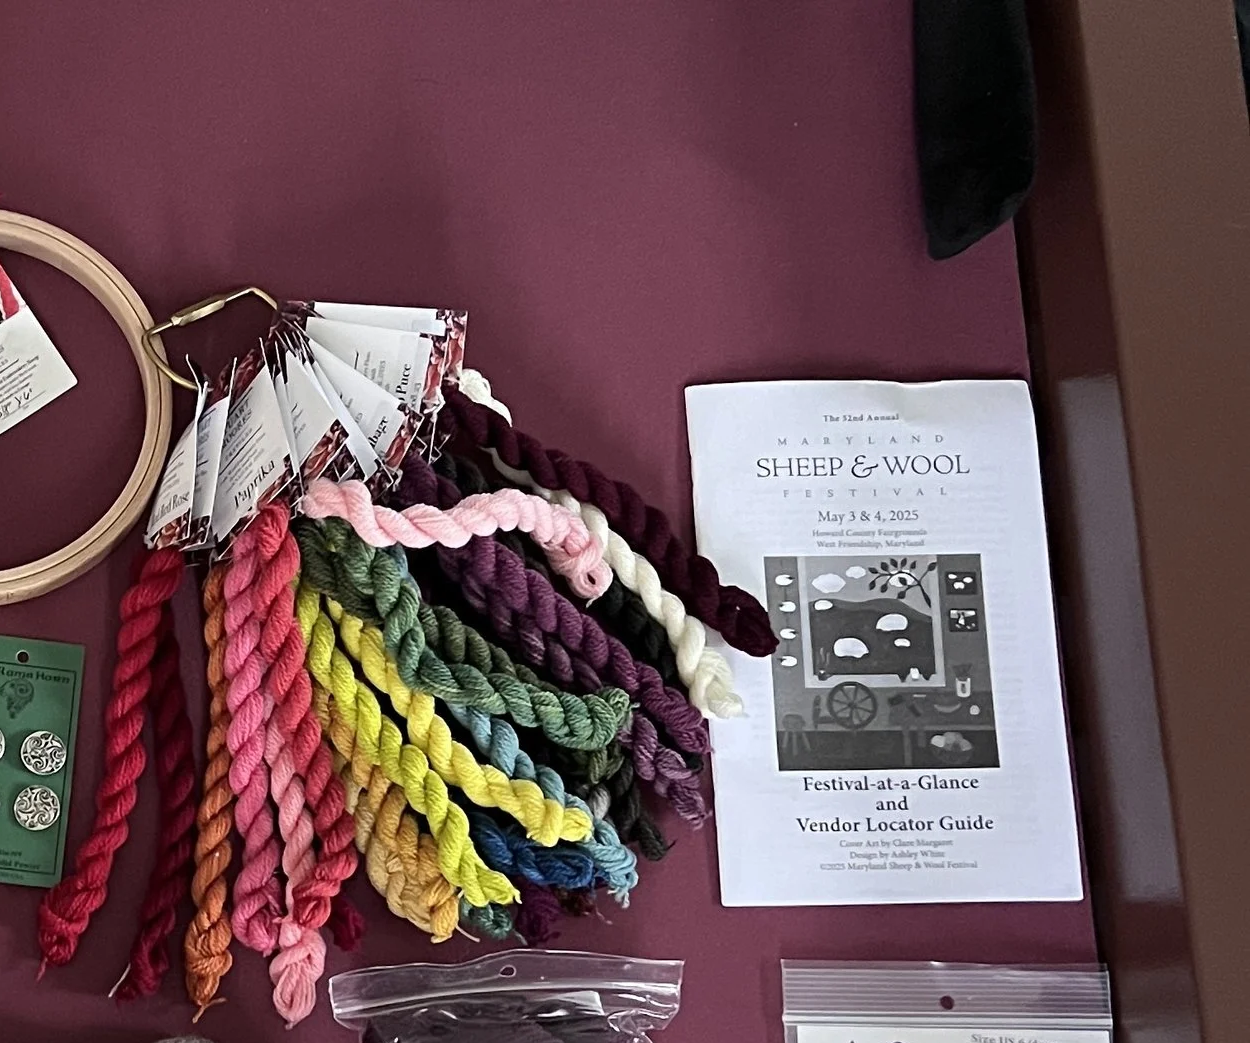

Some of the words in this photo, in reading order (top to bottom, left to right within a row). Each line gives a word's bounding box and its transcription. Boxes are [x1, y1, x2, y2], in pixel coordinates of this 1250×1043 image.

[396, 364, 411, 394] Puce
[867, 413, 899, 421] Annual
[778, 435, 945, 445] MARYLAND
[756, 456, 843, 478] SHEEP
[850, 455, 879, 478] &
[883, 455, 970, 476] WOOL
[234, 460, 275, 508] Paprika
[783, 487, 948, 498] FESTIVAL
[818, 511, 845, 525] May
[849, 511, 856, 521] 3
[860, 511, 870, 521] &
[874, 511, 886, 522] 4,
[890, 510, 919, 521] 2025
[803, 775, 979, 792] Festival-at-a-Glance
[876, 796, 909, 811] and
[797, 818, 860, 833] Vendor
[867, 817, 934, 832] Locator
[939, 815, 994, 831] Guide
[881, 840, 890, 849] by
[879, 851, 889, 860] by
[847, 863, 887, 872] Maryland
